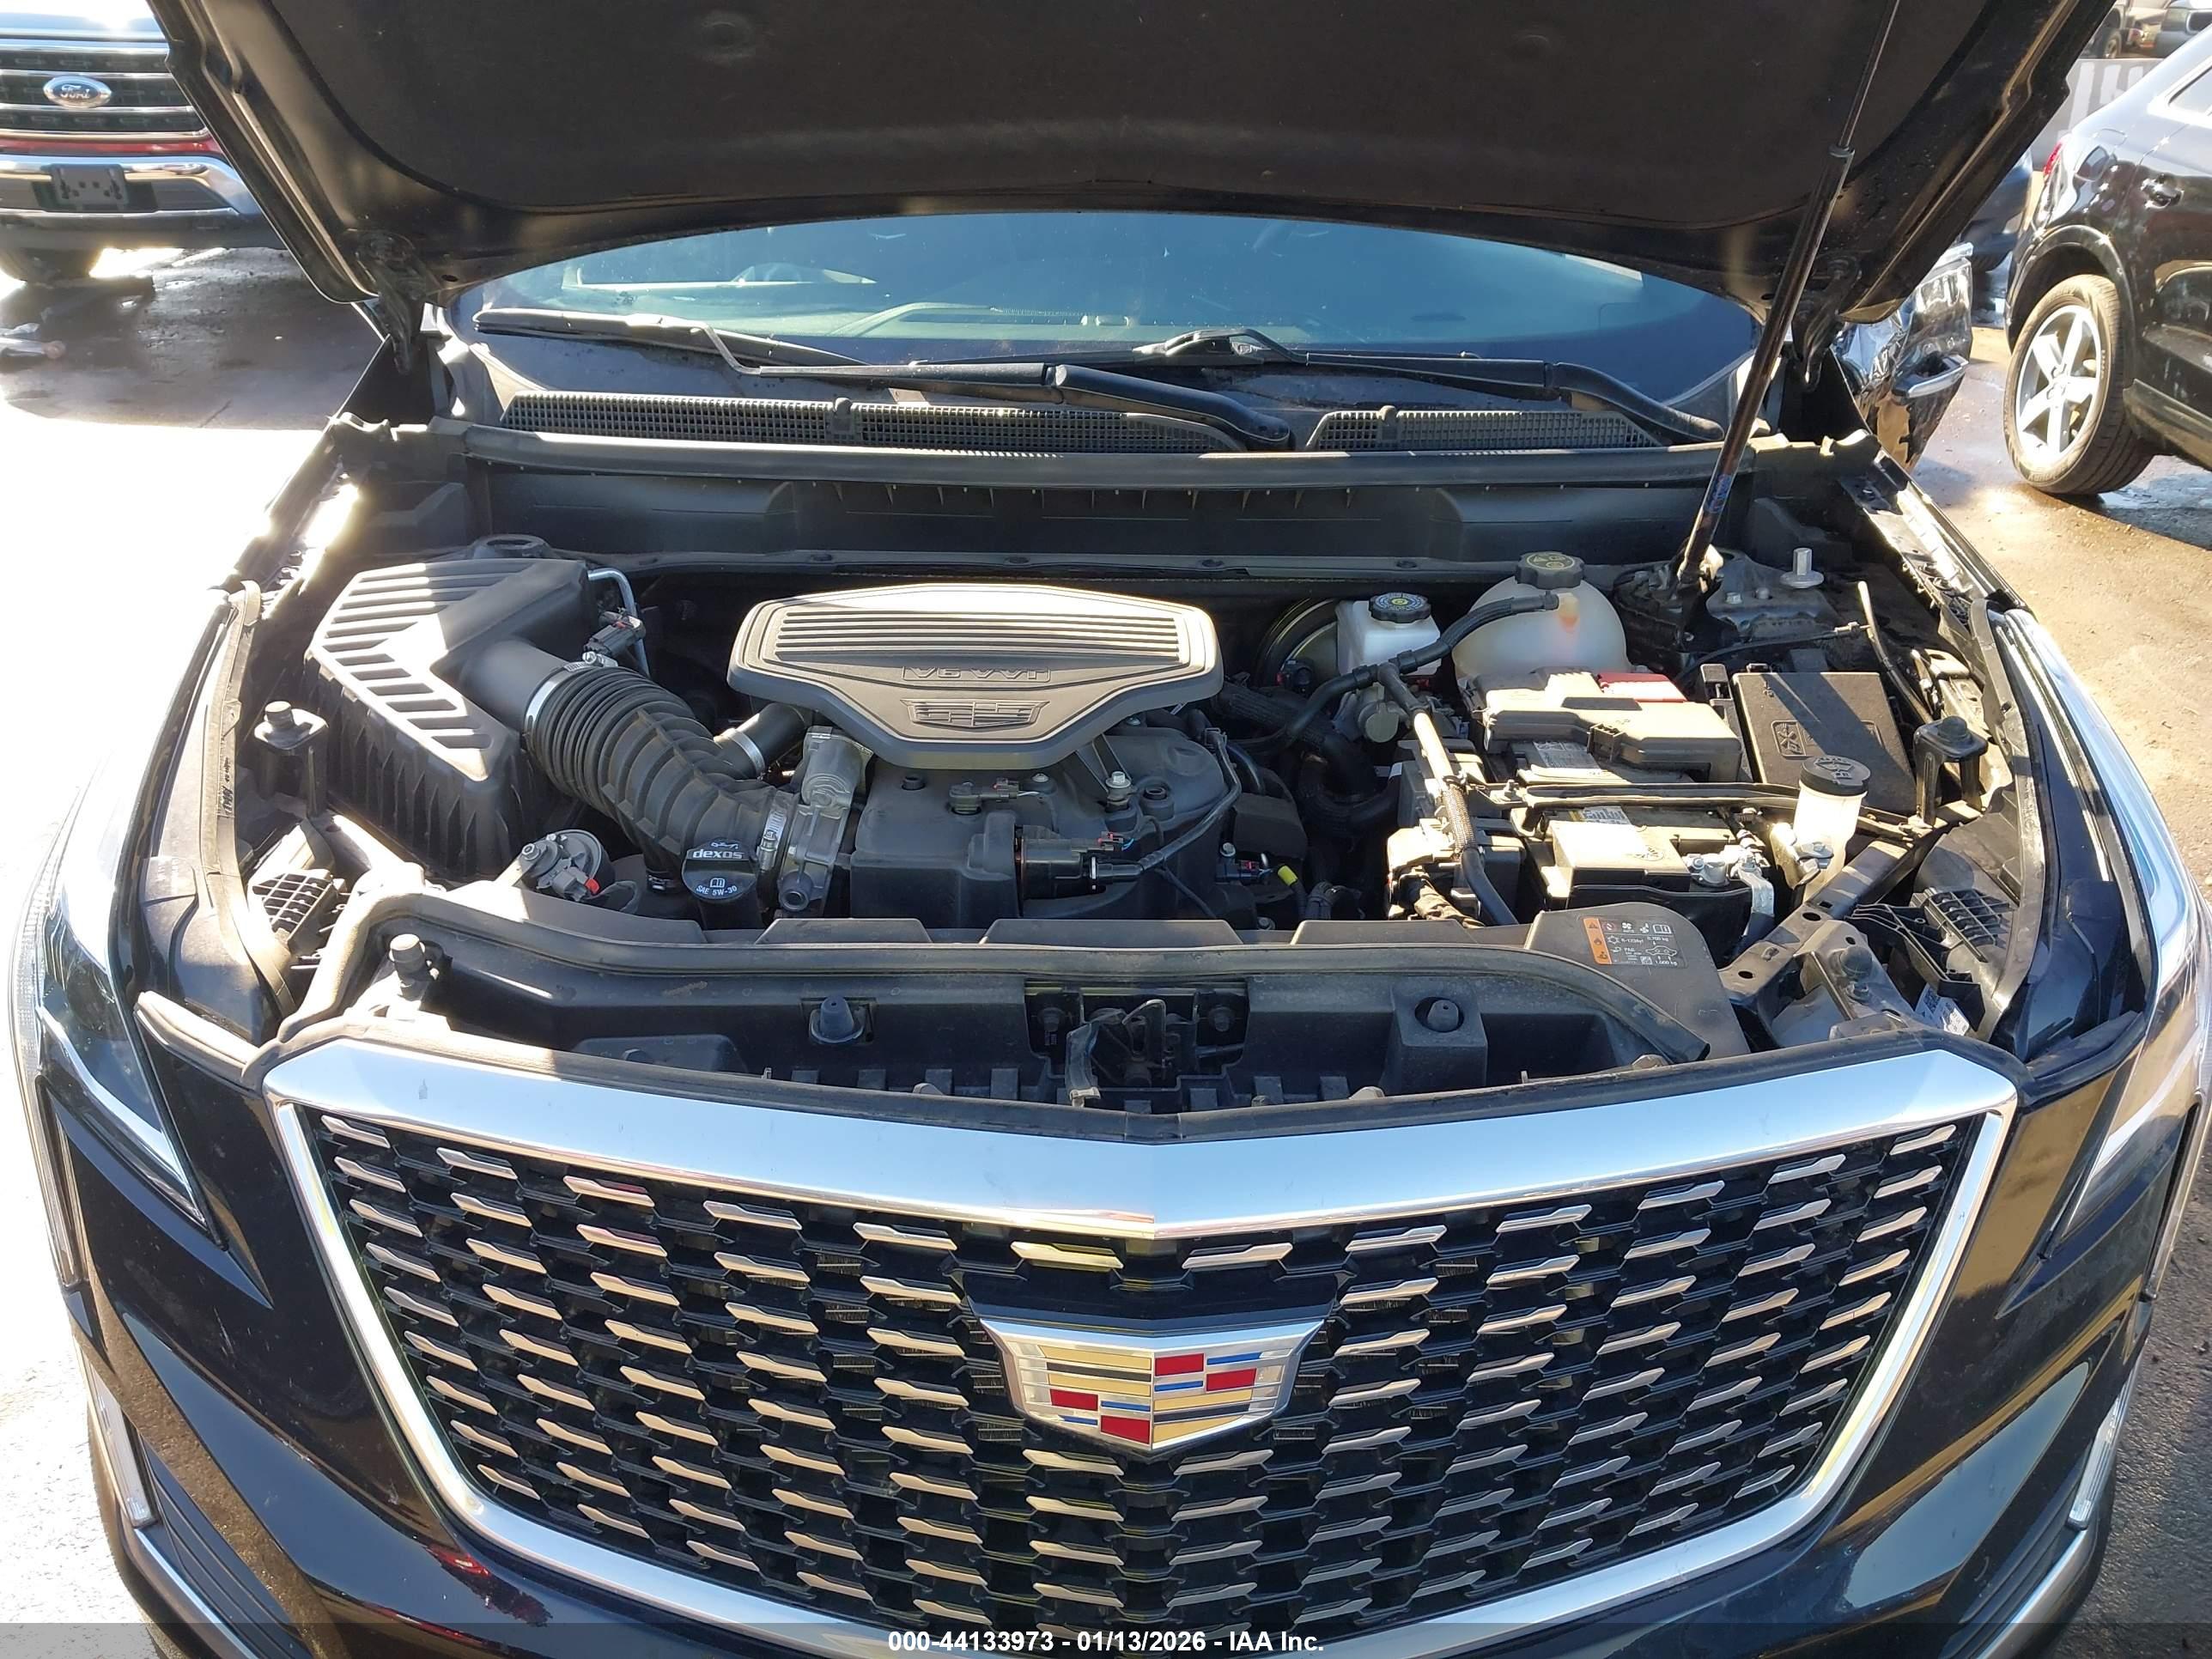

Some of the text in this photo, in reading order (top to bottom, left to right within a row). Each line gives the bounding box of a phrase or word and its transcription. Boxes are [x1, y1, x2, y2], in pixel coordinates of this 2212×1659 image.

[61, 84, 90, 99] Ford
[693, 849, 744, 859] dexos
[696, 885, 738, 896] SAE 5W-30
